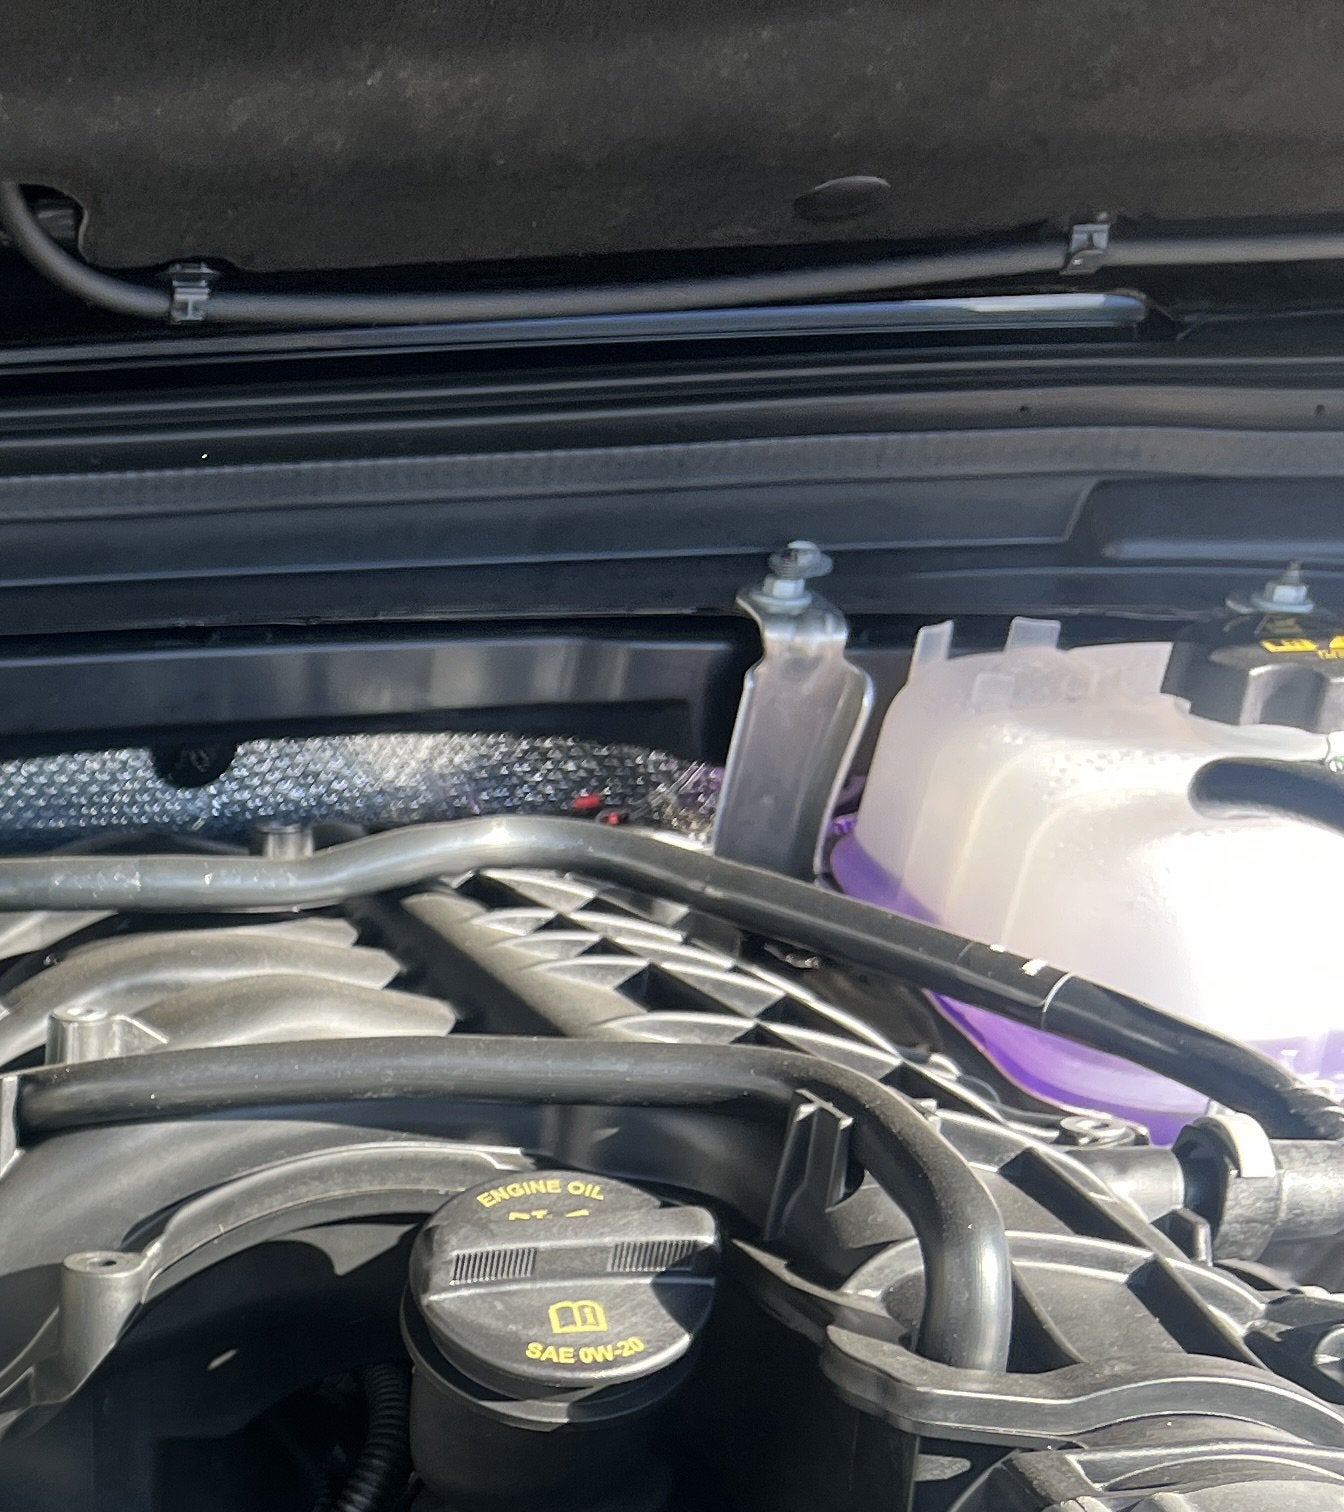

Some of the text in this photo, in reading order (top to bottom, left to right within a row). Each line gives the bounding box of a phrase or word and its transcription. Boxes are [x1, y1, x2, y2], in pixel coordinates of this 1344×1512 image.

[476, 1179, 604, 1208] ENGINE OIL
[525, 1337, 645, 1364] SAE 0W-20
